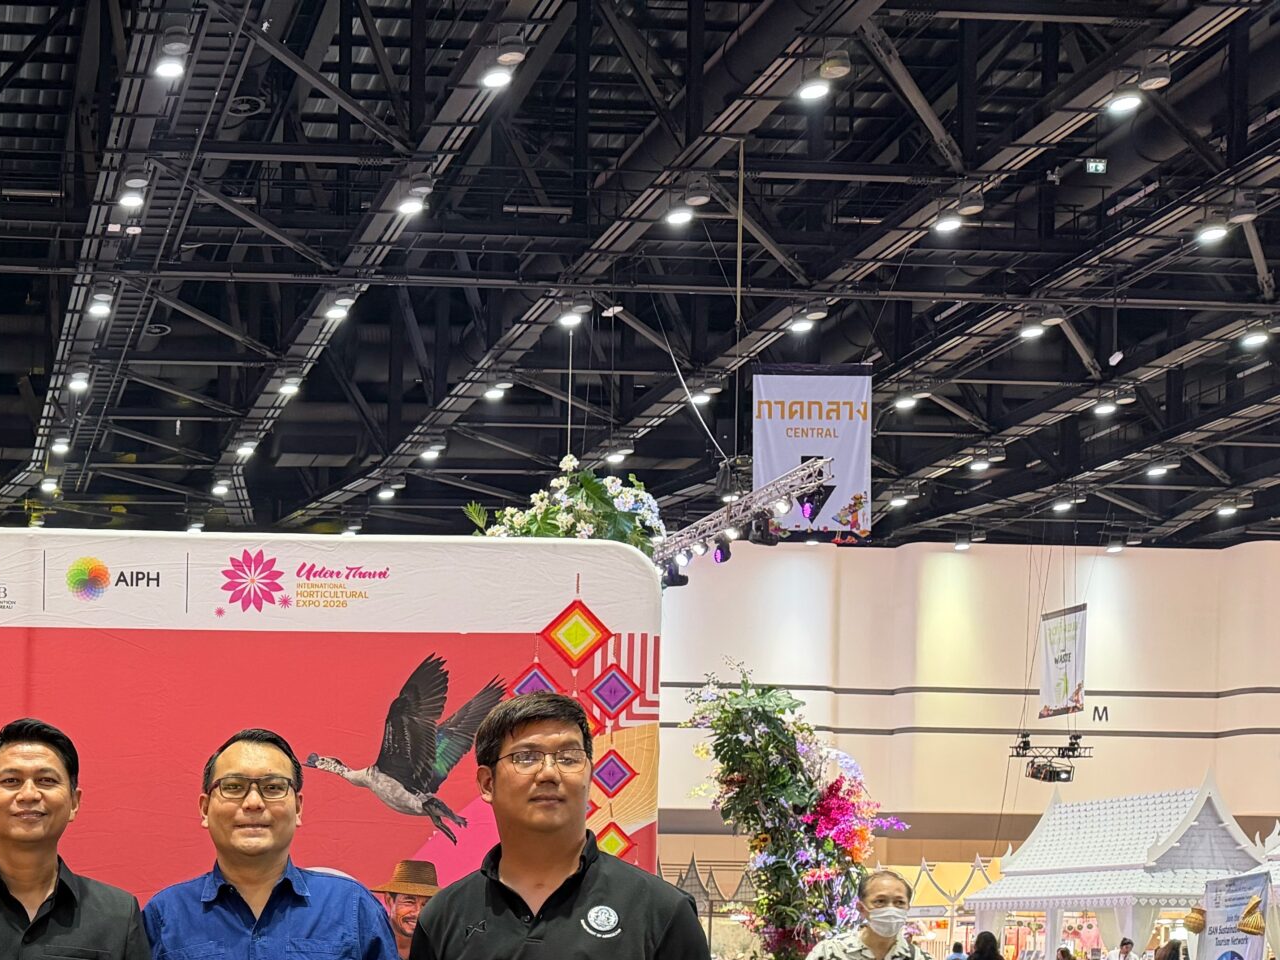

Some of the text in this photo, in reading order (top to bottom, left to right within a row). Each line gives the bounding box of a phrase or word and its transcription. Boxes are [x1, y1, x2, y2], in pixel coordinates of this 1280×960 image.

[755, 399, 868, 421] ภาคกลาง
[786, 427, 839, 438] CENTRAL
[115, 571, 160, 588] AIPH
[296, 562, 390, 581] Udon Thani
[296, 590, 368, 599] HORTICULTURAL
[296, 600, 348, 608] EXPO 2026
[1092, 705, 1109, 722] M
